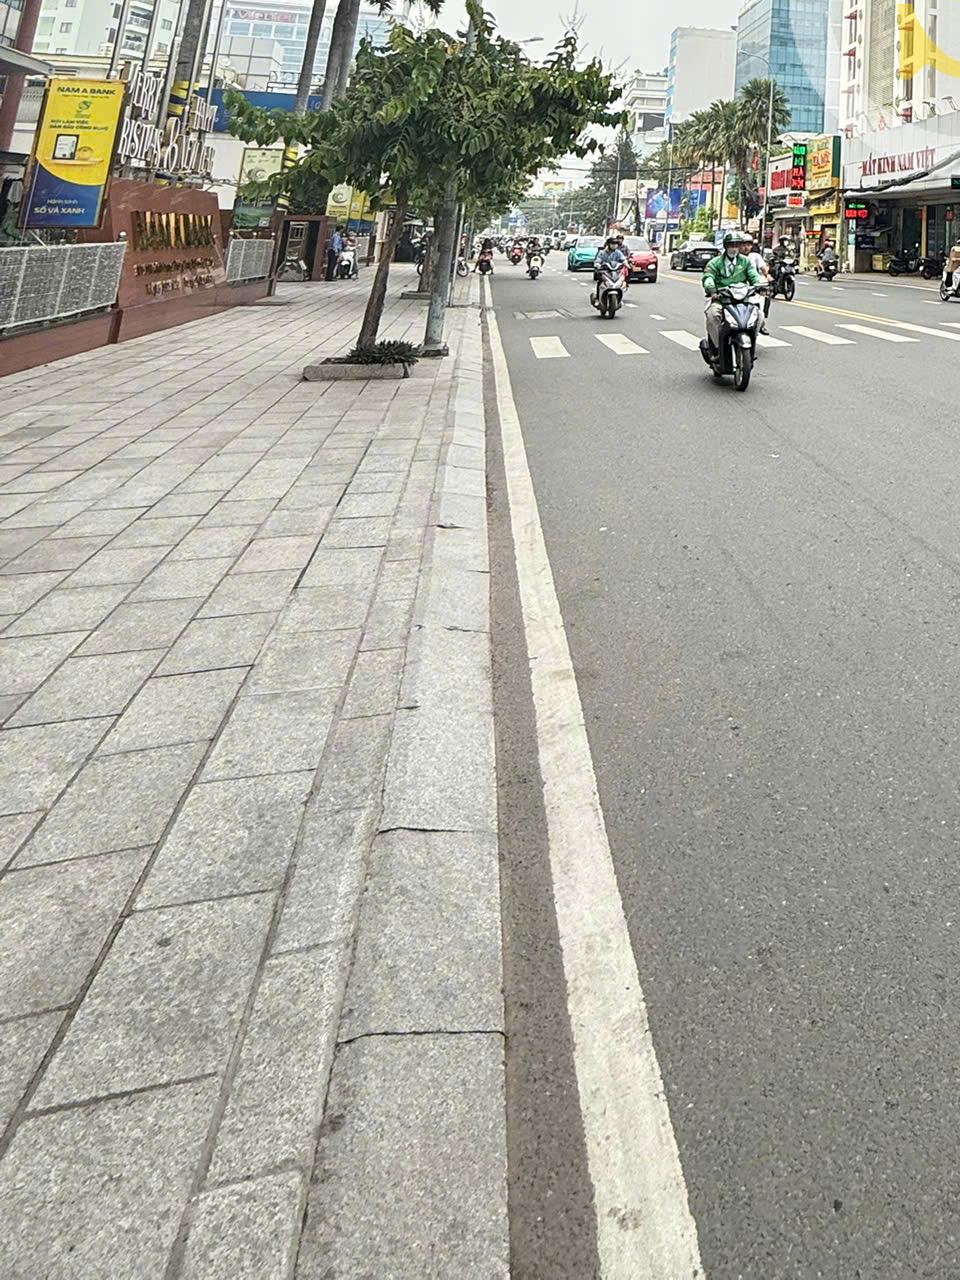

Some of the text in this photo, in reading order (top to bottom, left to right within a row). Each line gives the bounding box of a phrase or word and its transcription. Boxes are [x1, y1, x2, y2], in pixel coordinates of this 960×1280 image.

[57, 86, 117, 96] NAM A BANK
